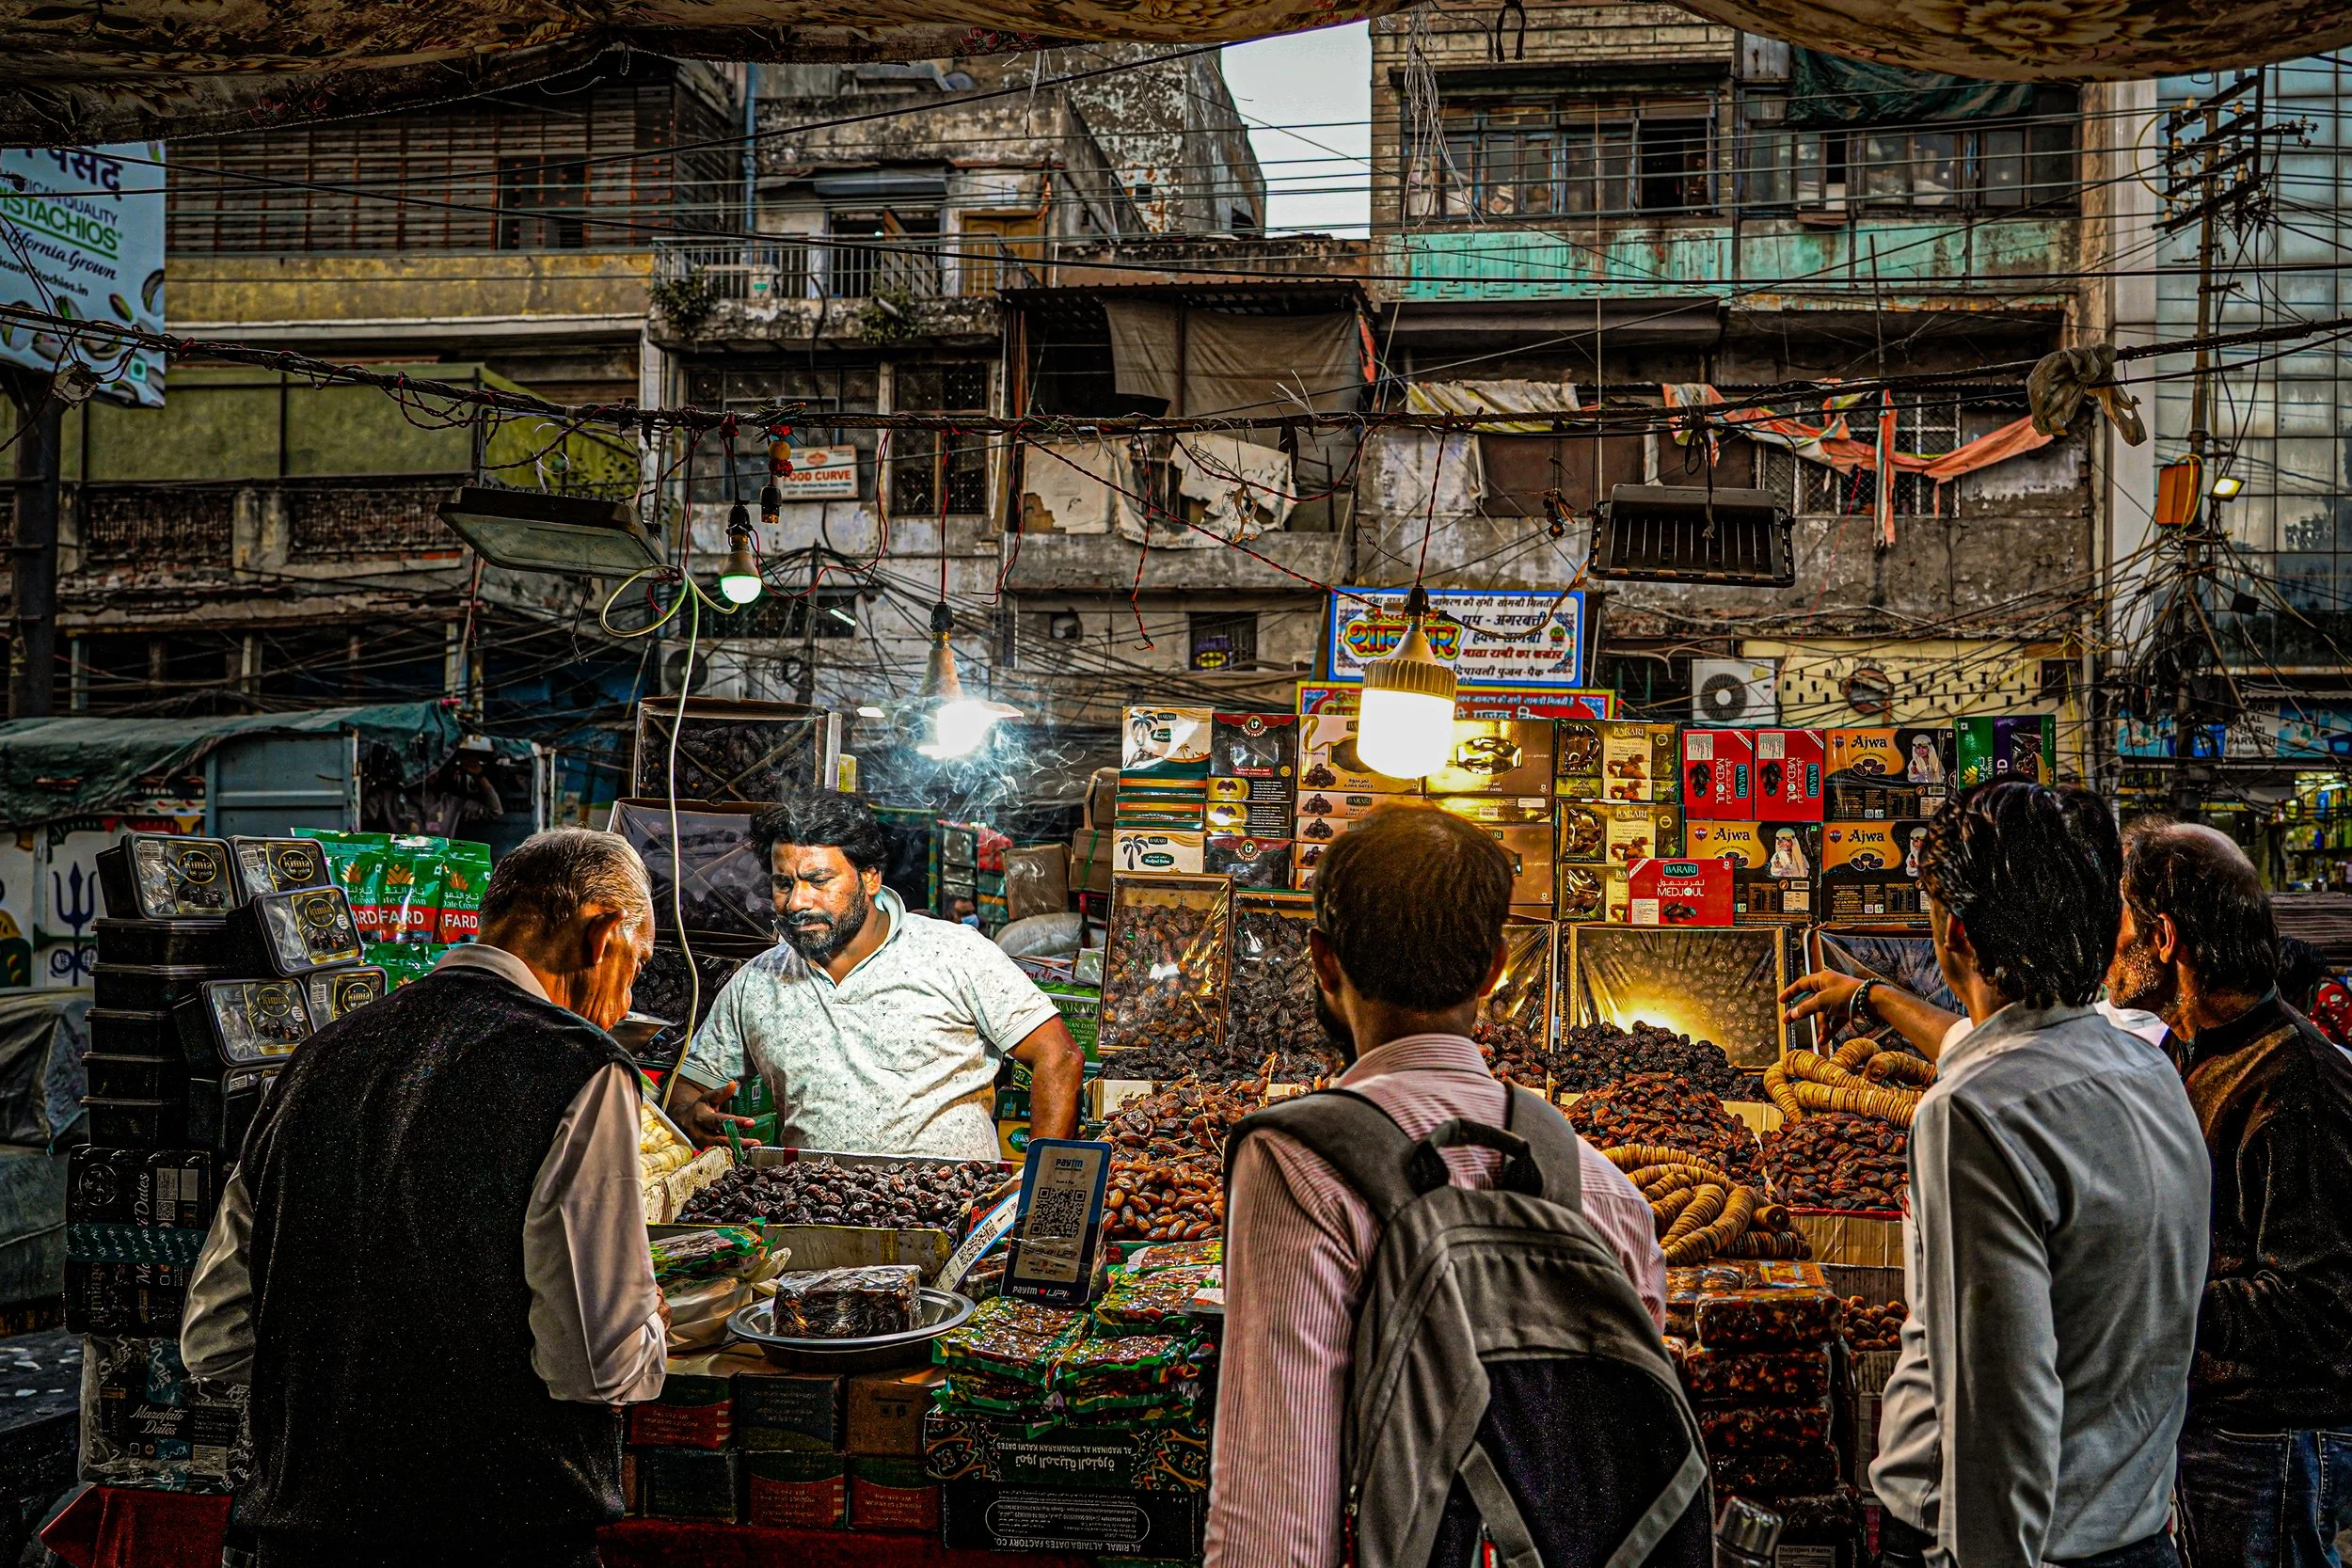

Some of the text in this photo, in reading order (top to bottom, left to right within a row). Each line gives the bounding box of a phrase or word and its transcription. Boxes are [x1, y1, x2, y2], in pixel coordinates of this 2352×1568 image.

[0, 187, 119, 251] ISTACHIOS
[68, 250, 118, 280] Grown
[815, 470, 851, 482] CURVE
[1463, 596, 1474, 607] की
[1613, 727, 1645, 736] BARARI
[1851, 734, 1888, 750] Ajwa
[1738, 766, 1747, 798] BARARI
[1809, 765, 1818, 796] BARARI
[1347, 797, 1371, 805] BARARI
[1616, 810, 1647, 818] BARARI
[1713, 828, 1751, 843] Ajwa
[1848, 829, 1885, 845] Ajwa
[1665, 865, 1696, 874] BARARI
[1657, 887, 1705, 896] MEDJOUL
[352, 911, 377, 925] ARD
[379, 911, 424, 925] FARD
[444, 913, 478, 928] FARD
[1055, 1001, 1099, 1014] BARARI
[134, 1173, 151, 1215] Dates
[1045, 1289, 1070, 1298] UPI
[129, 1404, 189, 1424] Mazafati
[140, 1420, 178, 1436] Dates
[996, 1442, 1017, 1450] DATES
[1019, 1443, 1038, 1451] KALMI
[1039, 1445, 1081, 1453] MONAWARAH
[1092, 1446, 1122, 1454] MADINAH
[1123, 1447, 1132, 1455] AL
[1015, 1454, 1115, 1472] تمور المدينة المنورة
[993, 1537, 1141, 1552] AL RIMAL ALTAIBA DATES FACTORY CO.
